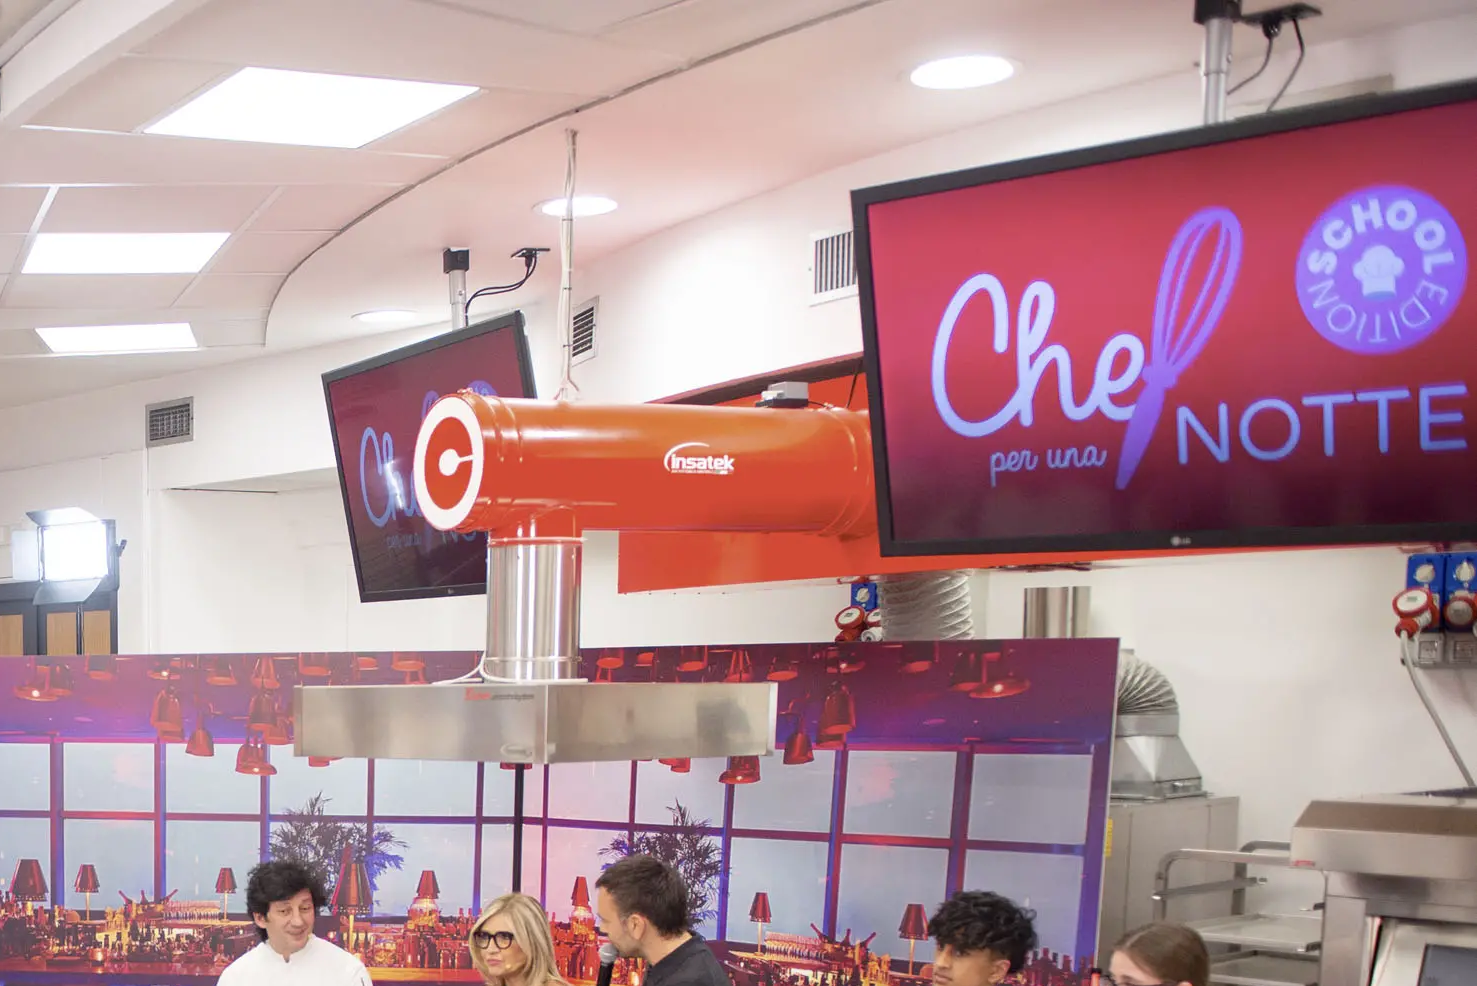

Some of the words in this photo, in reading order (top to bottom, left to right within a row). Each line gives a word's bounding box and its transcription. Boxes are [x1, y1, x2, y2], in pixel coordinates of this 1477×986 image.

[1307, 198, 1455, 274] SCHOOL
[931, 206, 1243, 490] Chef
[1308, 278, 1448, 345] EDITION
[671, 454, 735, 471] insatek
[990, 449, 1038, 488] per
[1046, 445, 1107, 469] una
[1176, 382, 1468, 465] NOTTE
